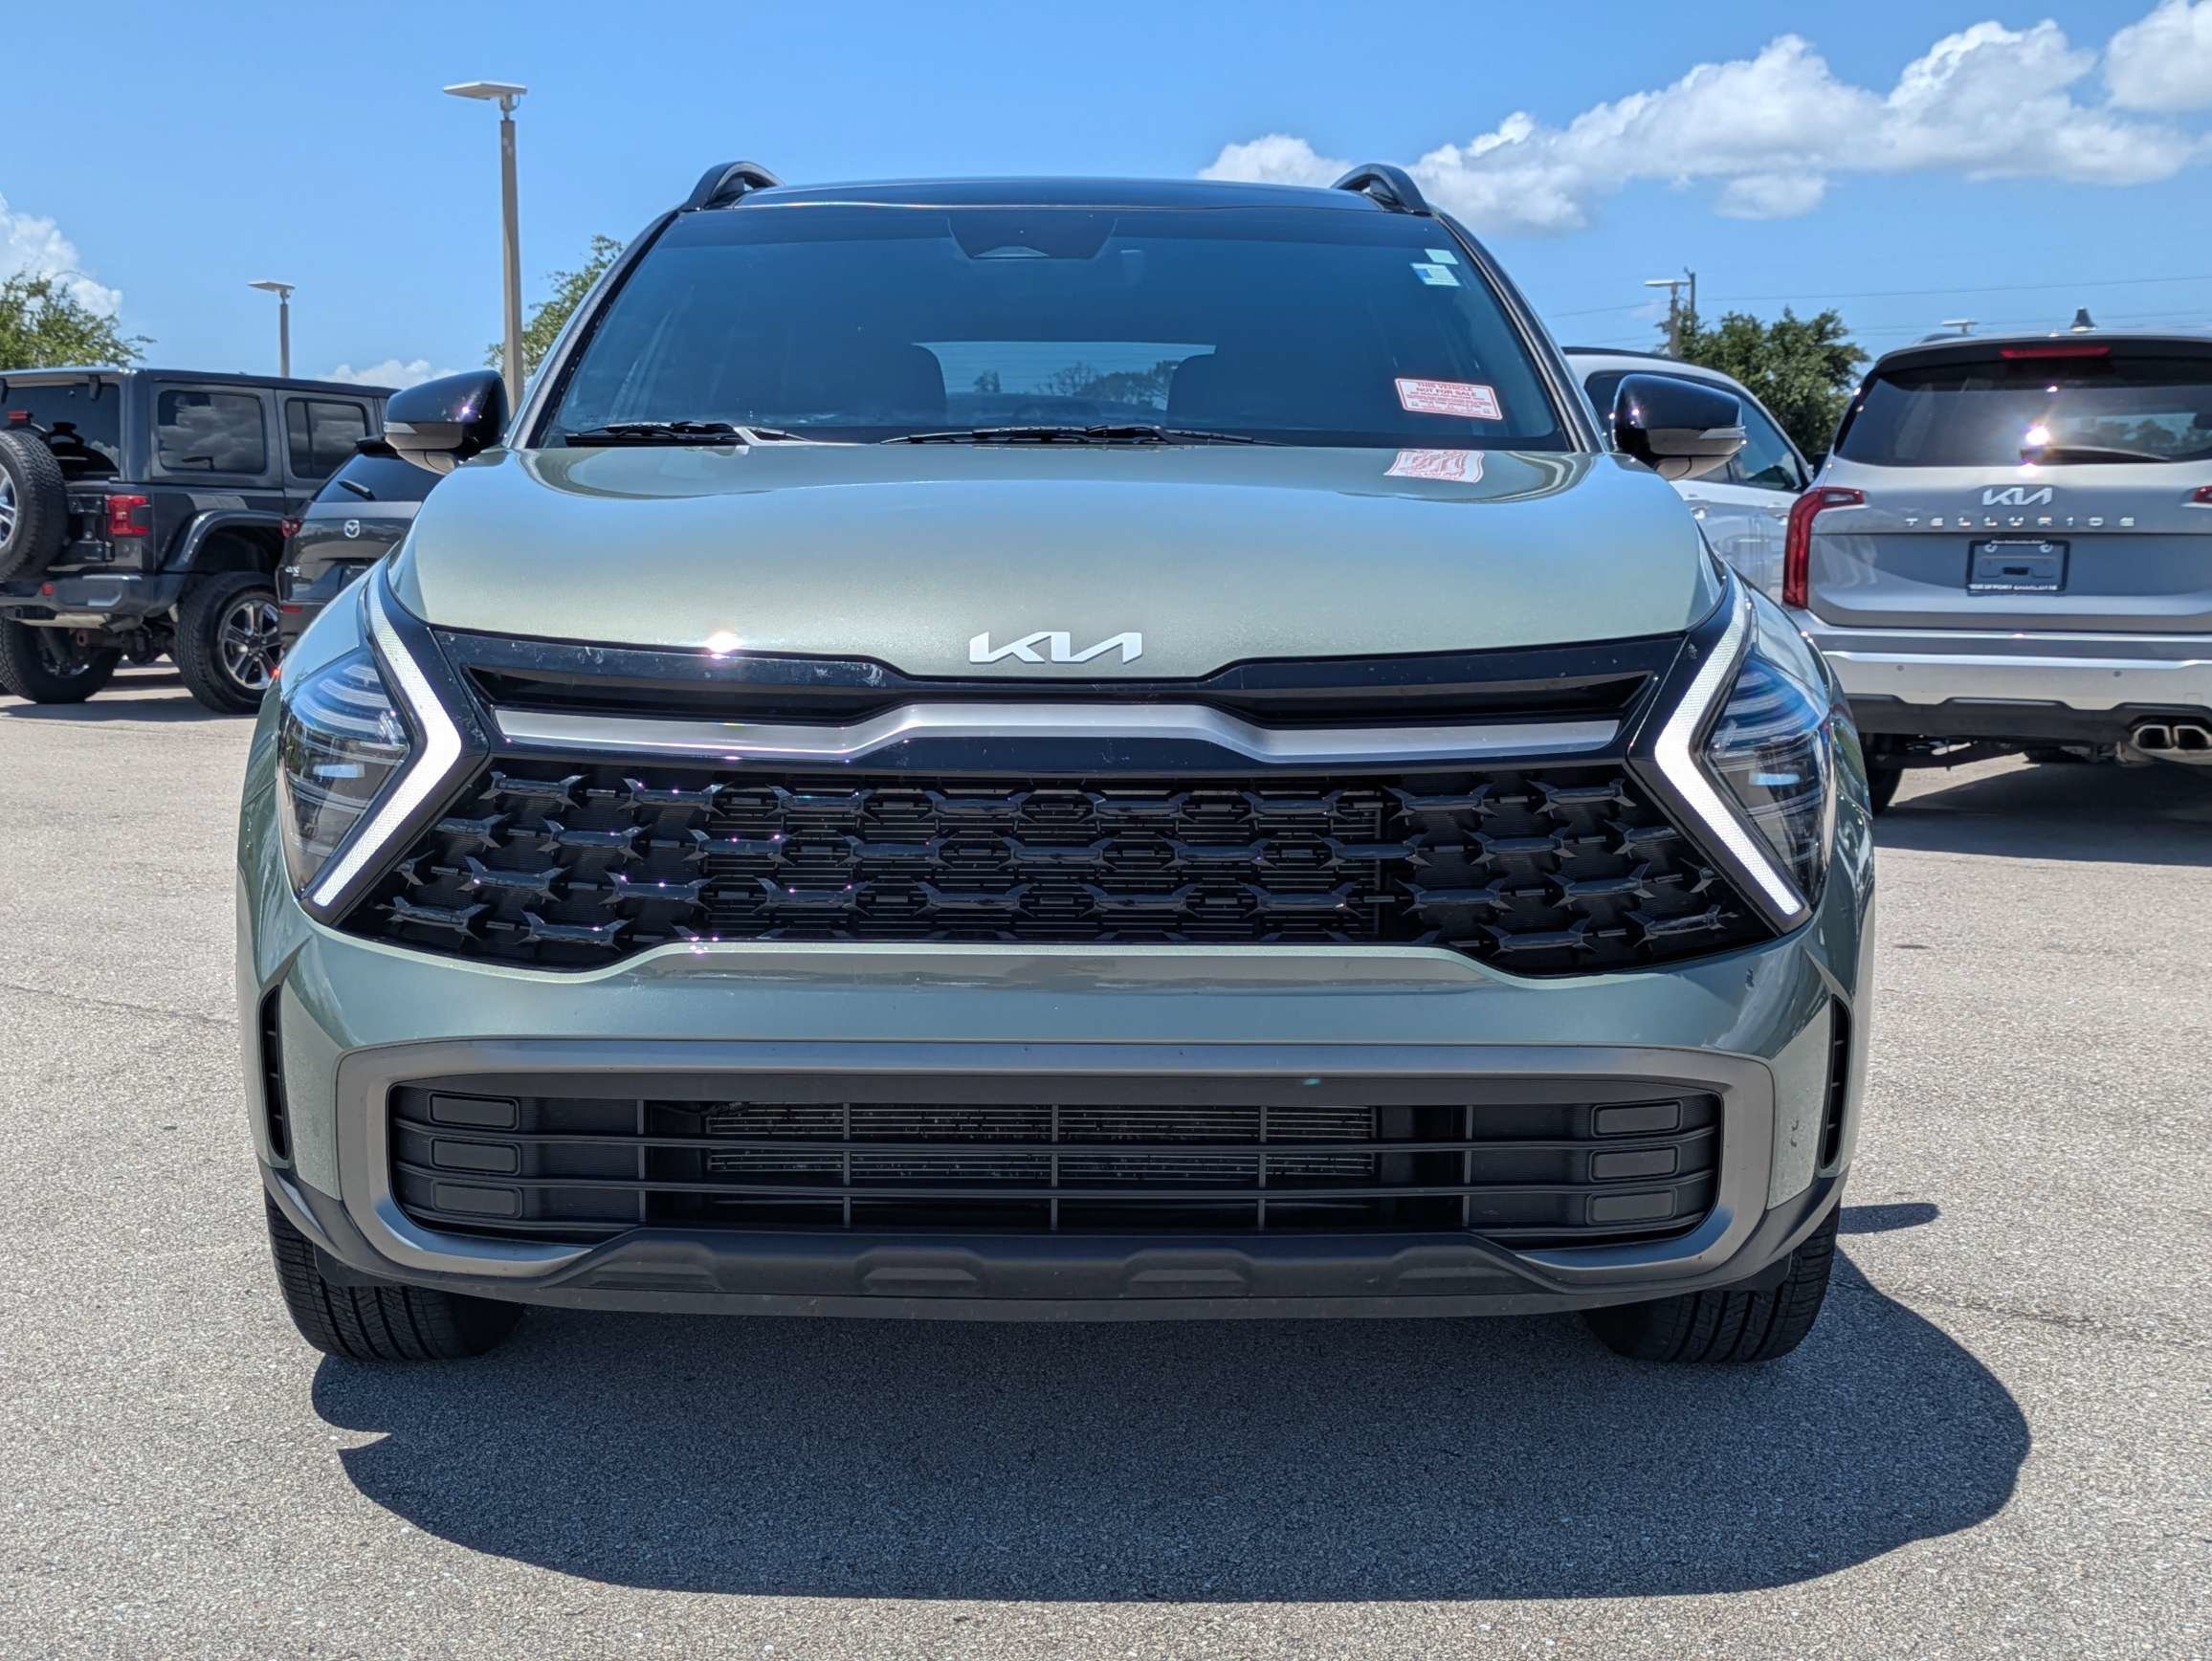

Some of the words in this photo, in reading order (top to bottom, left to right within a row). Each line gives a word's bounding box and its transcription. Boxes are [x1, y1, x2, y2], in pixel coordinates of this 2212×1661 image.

[1982, 487, 2053, 506] KIA
[1905, 517, 2135, 527] TELLURIDE
[969, 631, 1142, 664] KIA
